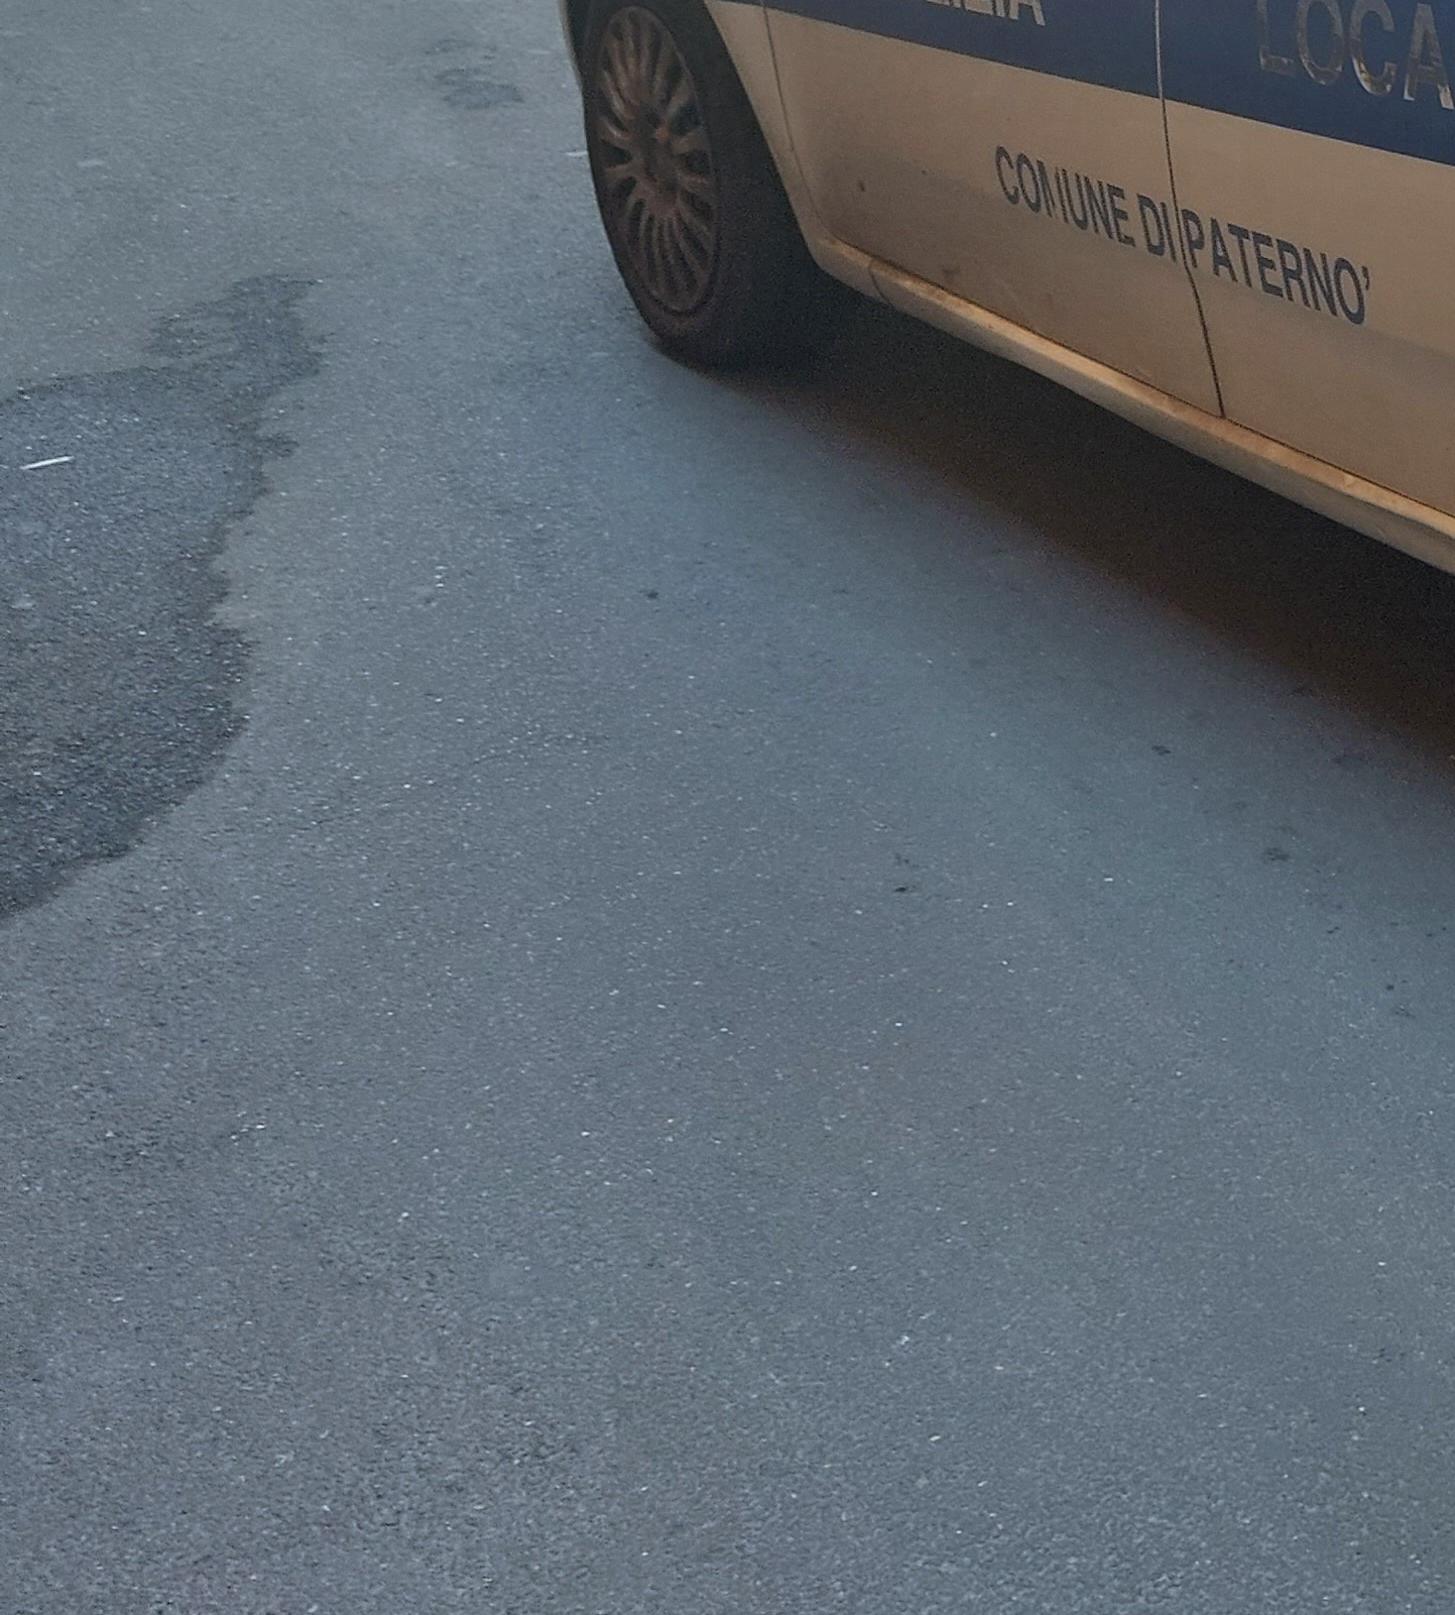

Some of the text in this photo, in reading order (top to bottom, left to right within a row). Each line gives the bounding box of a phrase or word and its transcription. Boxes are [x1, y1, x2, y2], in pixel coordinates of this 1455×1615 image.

[995, 145, 1371, 326] COMUNE DI PATERNO'
